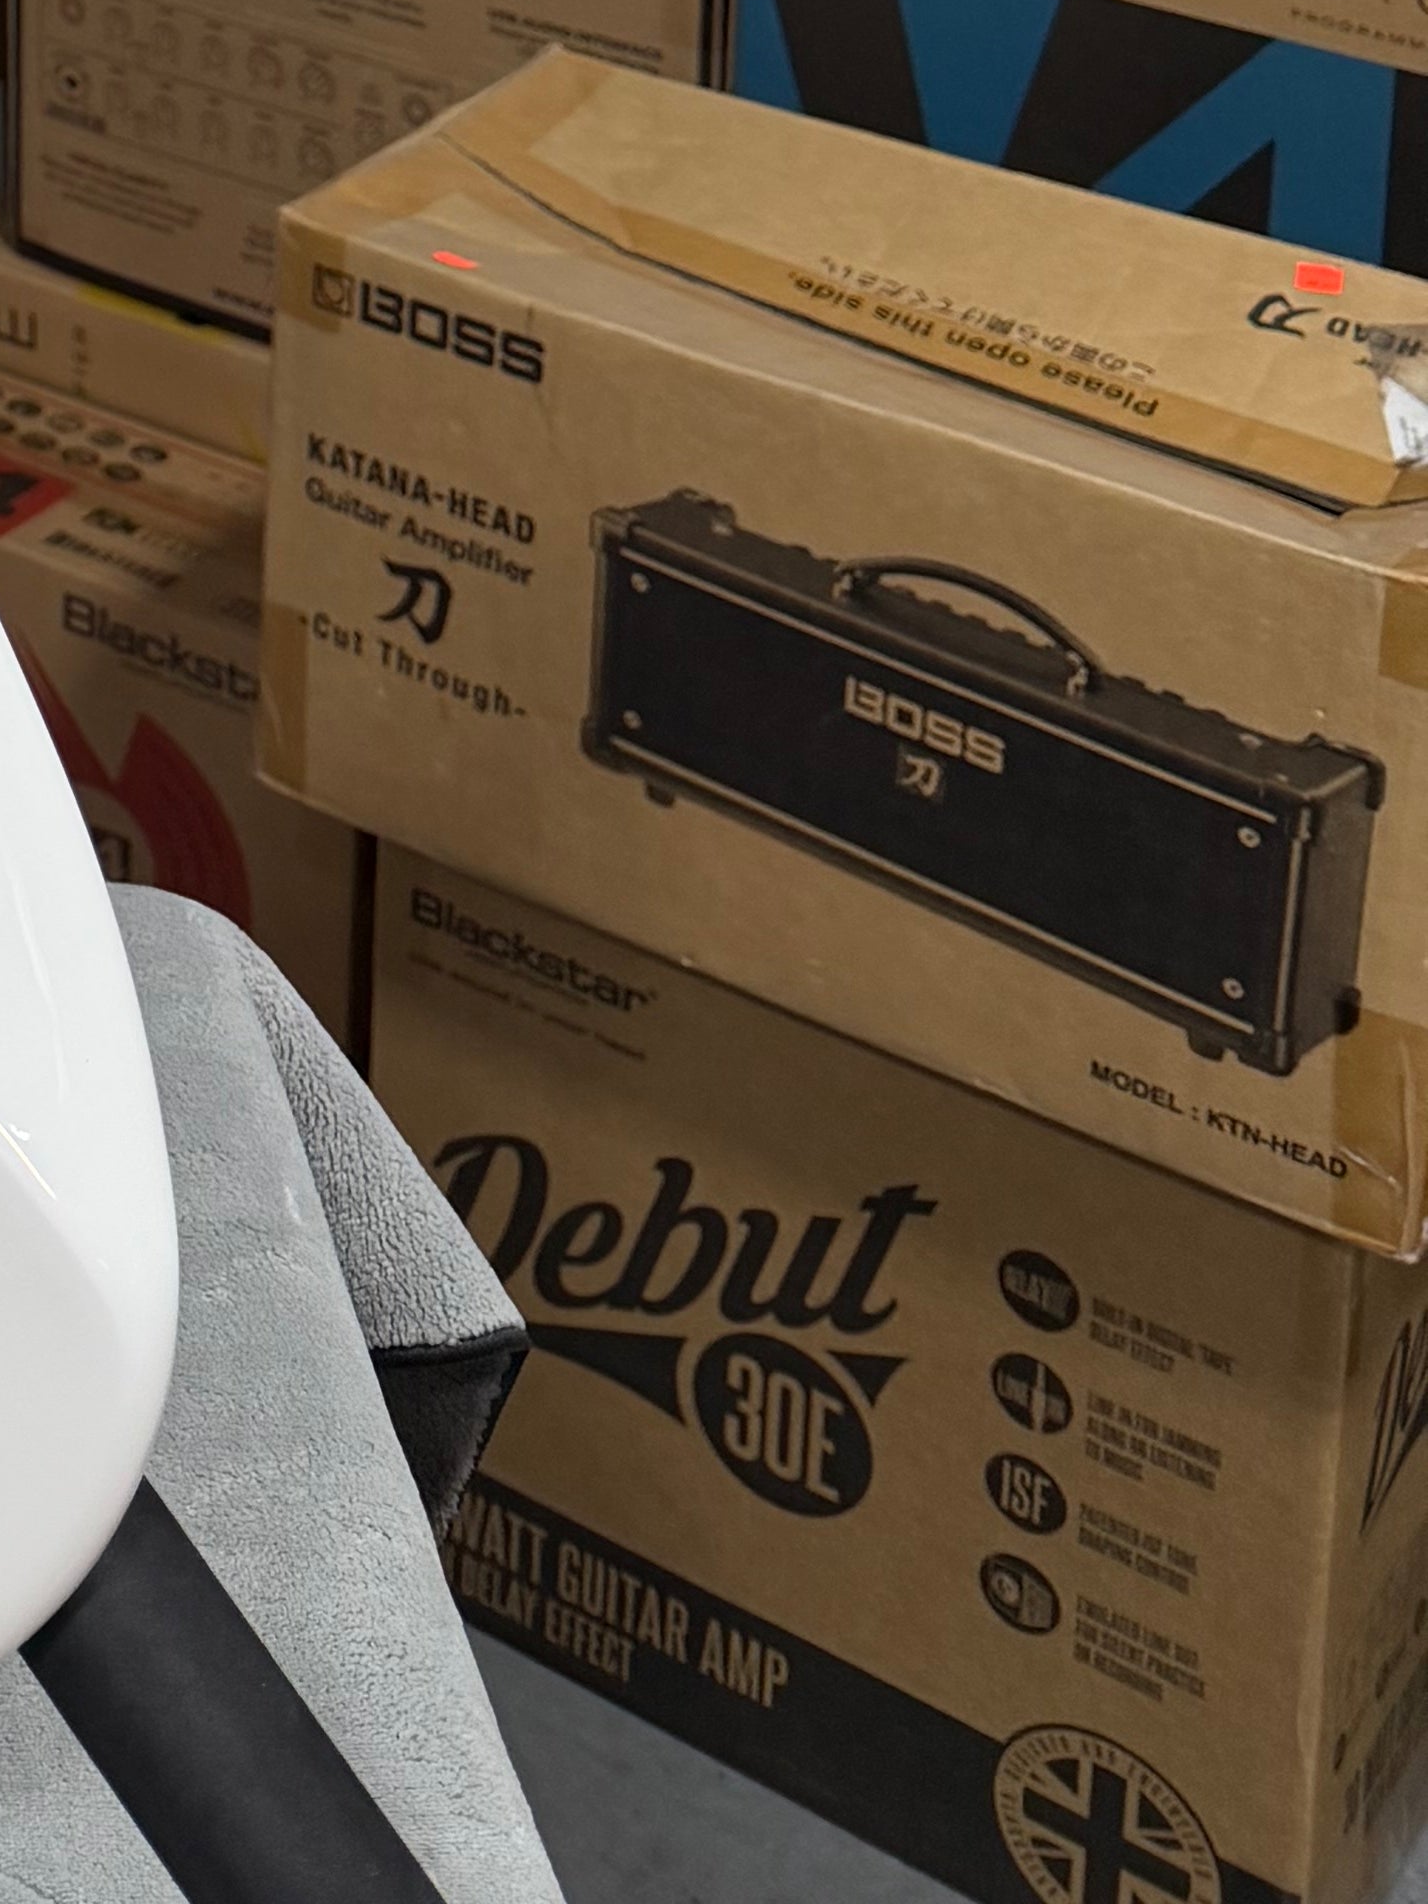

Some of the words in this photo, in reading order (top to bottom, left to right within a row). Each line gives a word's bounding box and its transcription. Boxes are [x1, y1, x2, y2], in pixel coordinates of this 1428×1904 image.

[361, 279, 545, 385] BOSS
[871, 299, 942, 349] this
[947, 322, 1033, 385] open
[1040, 357, 1160, 420] Please
[304, 476, 393, 533] Guitar
[399, 515, 536, 587] Amplifier
[306, 432, 538, 545] KATANA-HEAD
[375, 554, 454, 647] 刀
[843, 673, 1006, 776] BOSS
[408, 886, 656, 1015] Blackstar
[1090, 1059, 1184, 1117] MODEL
[1205, 1107, 1348, 1179] KTN-HEAD
[432, 1132, 938, 1336] Debut
[723, 1356, 844, 1505] 30E
[998, 1458, 1053, 1525] ISF
[460, 1556, 541, 1632] DELAY
[544, 1598, 635, 1684] EFFECT
[557, 1541, 691, 1665] GUITAR
[698, 1617, 790, 1709] AMP
